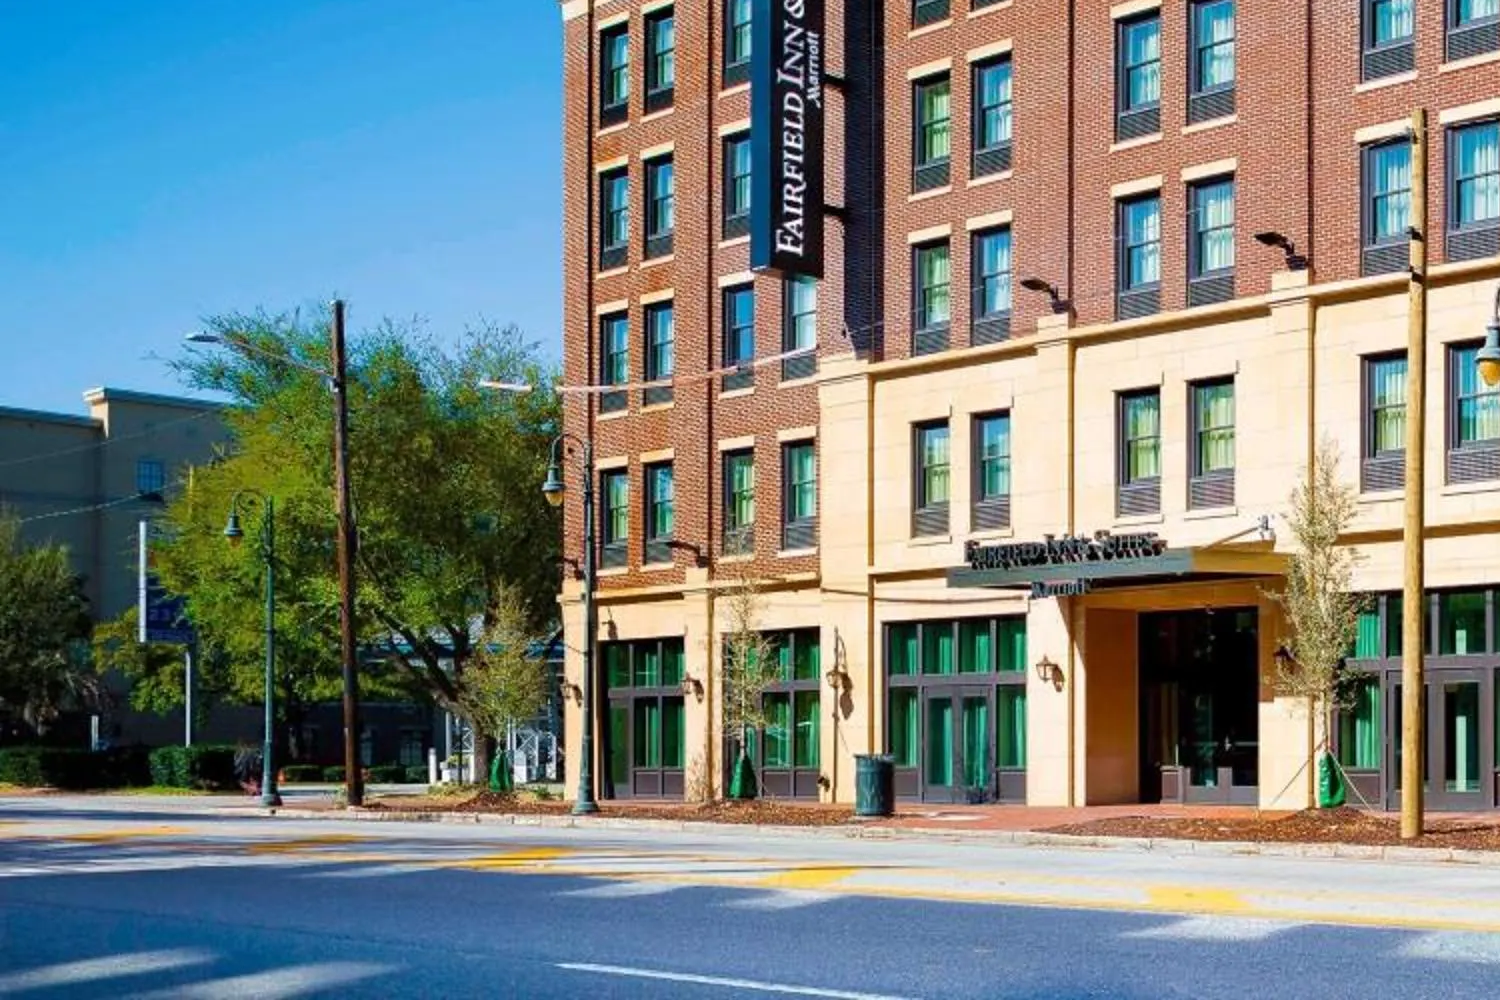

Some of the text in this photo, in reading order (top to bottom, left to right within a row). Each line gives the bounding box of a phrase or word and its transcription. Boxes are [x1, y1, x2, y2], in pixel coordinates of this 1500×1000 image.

[777, 20, 805, 89] INN
[806, 30, 821, 109] Marriott
[776, 92, 807, 257] FAIRFIELD
